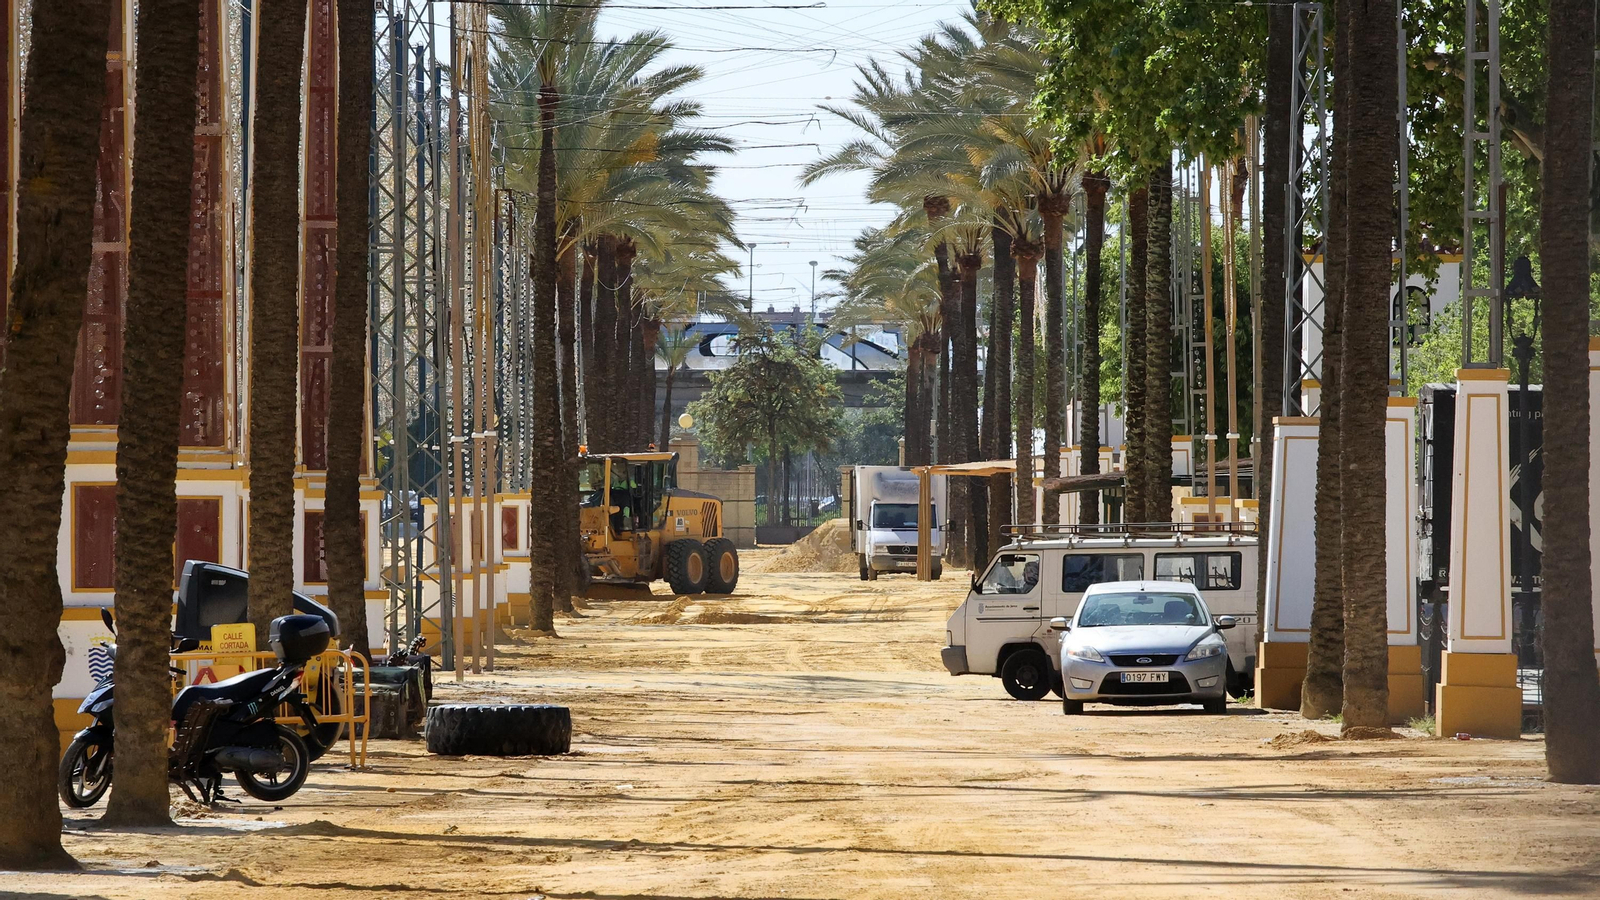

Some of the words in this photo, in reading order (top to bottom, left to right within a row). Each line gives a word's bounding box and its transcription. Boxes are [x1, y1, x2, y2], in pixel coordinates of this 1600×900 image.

[223, 632, 243, 640] CALLE
[219, 641, 249, 650] CORTADA
[1126, 673, 1147, 682] 0197
[1150, 673, 1167, 682] FWY
